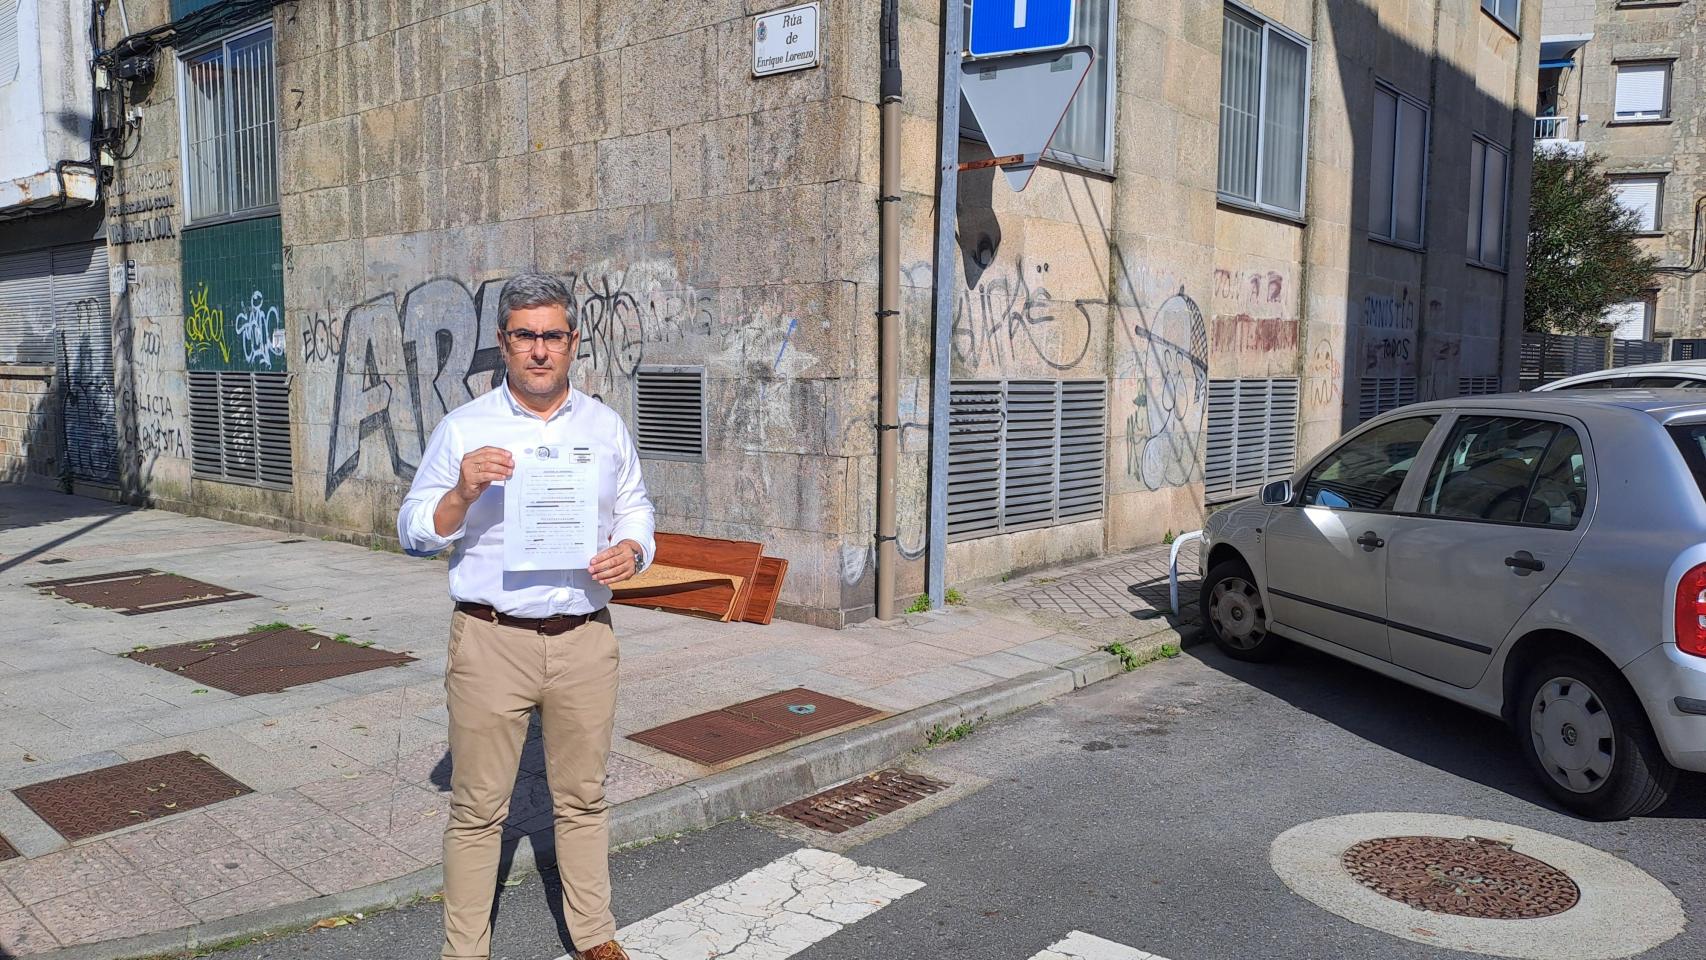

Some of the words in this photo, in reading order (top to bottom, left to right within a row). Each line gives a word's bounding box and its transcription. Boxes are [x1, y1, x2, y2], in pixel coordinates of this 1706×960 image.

[782, 14, 803, 28] Rúa
[785, 31, 798, 45] de
[756, 56, 784, 68] Enrique
[785, 51, 814, 62] Lorenzo
[1382, 338, 1411, 360] TODOS
[123, 390, 174, 420] GALICIA
